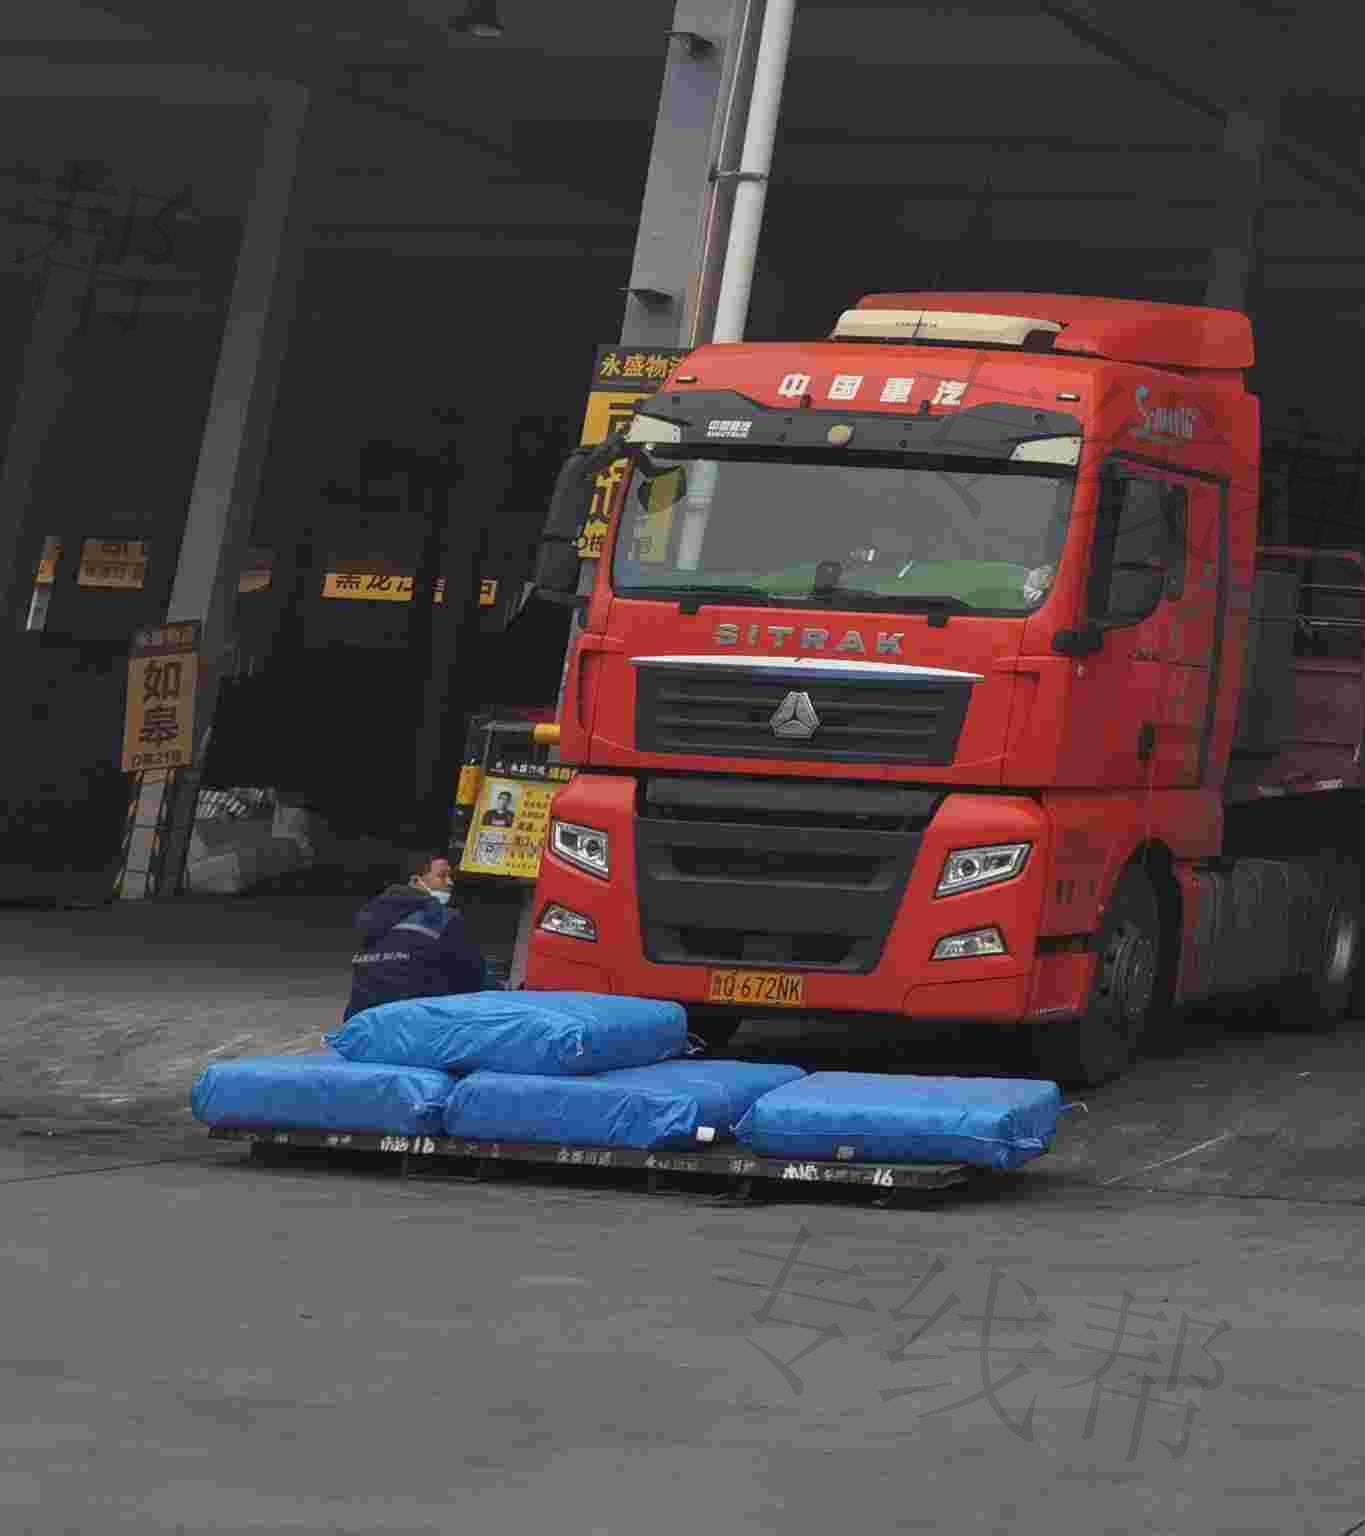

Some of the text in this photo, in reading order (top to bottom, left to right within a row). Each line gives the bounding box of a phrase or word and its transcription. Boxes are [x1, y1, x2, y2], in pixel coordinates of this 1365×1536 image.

[777, 372, 967, 408] 中国重汽
[711, 622, 906, 656] SITRAK
[139, 658, 185, 749] 如皋
